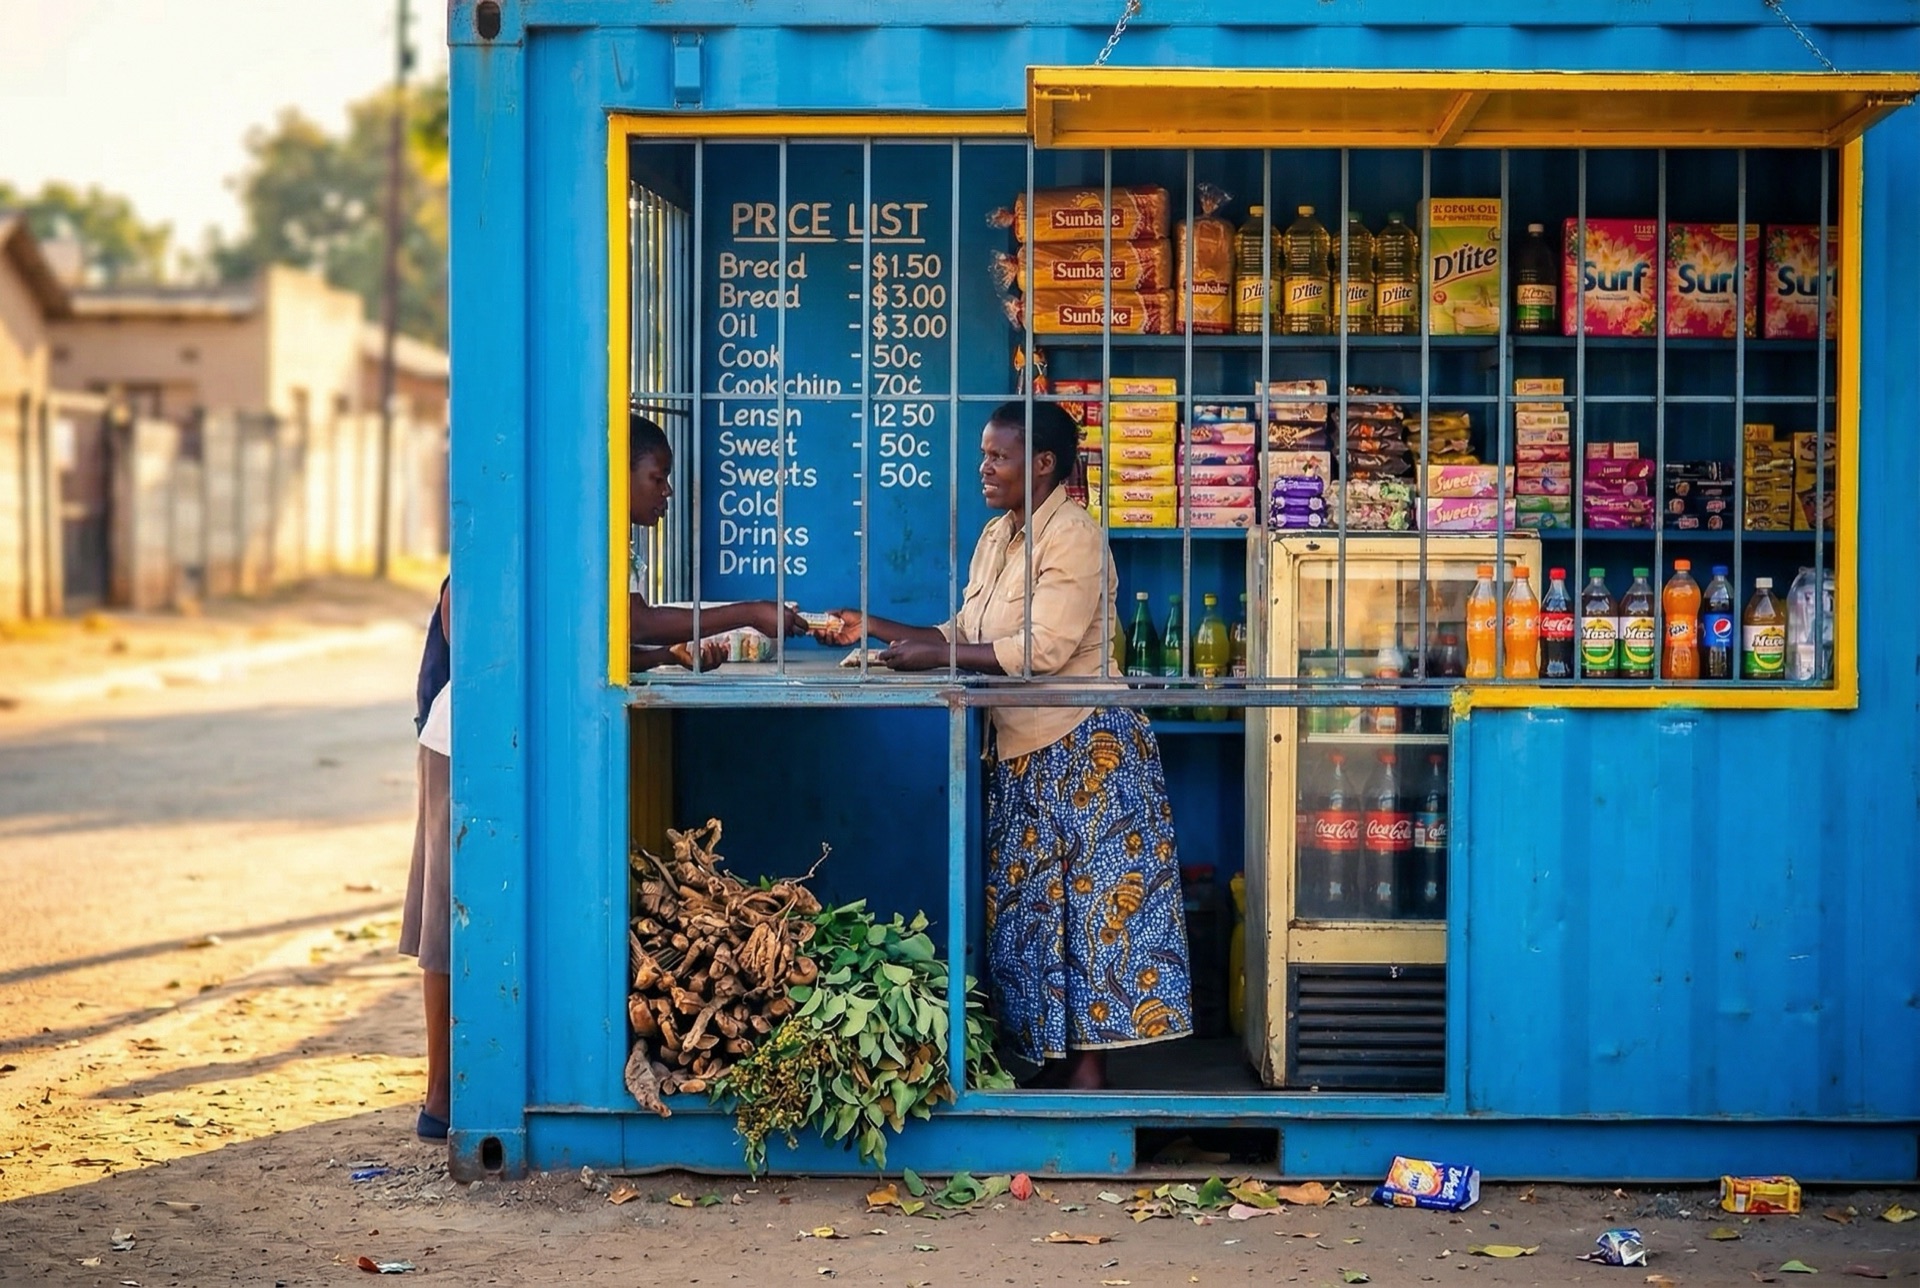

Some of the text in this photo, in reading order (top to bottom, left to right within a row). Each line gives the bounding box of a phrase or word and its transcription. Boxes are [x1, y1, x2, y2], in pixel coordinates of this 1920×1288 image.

[733, 203, 928, 235] PRCE LIST
[1055, 211, 1121, 228] Sunbae
[719, 252, 808, 279] Bread
[872, 252, 942, 281] $1.50
[719, 282, 801, 309] Bread
[872, 282, 946, 310] $3.00
[718, 312, 758, 338] Oil
[872, 312, 947, 340] $3.00
[872, 344, 922, 368] 50c
[719, 431, 798, 456] Sweet
[879, 433, 931, 458] 50c
[879, 462, 932, 488] 50c
[719, 490, 780, 517] Cold
